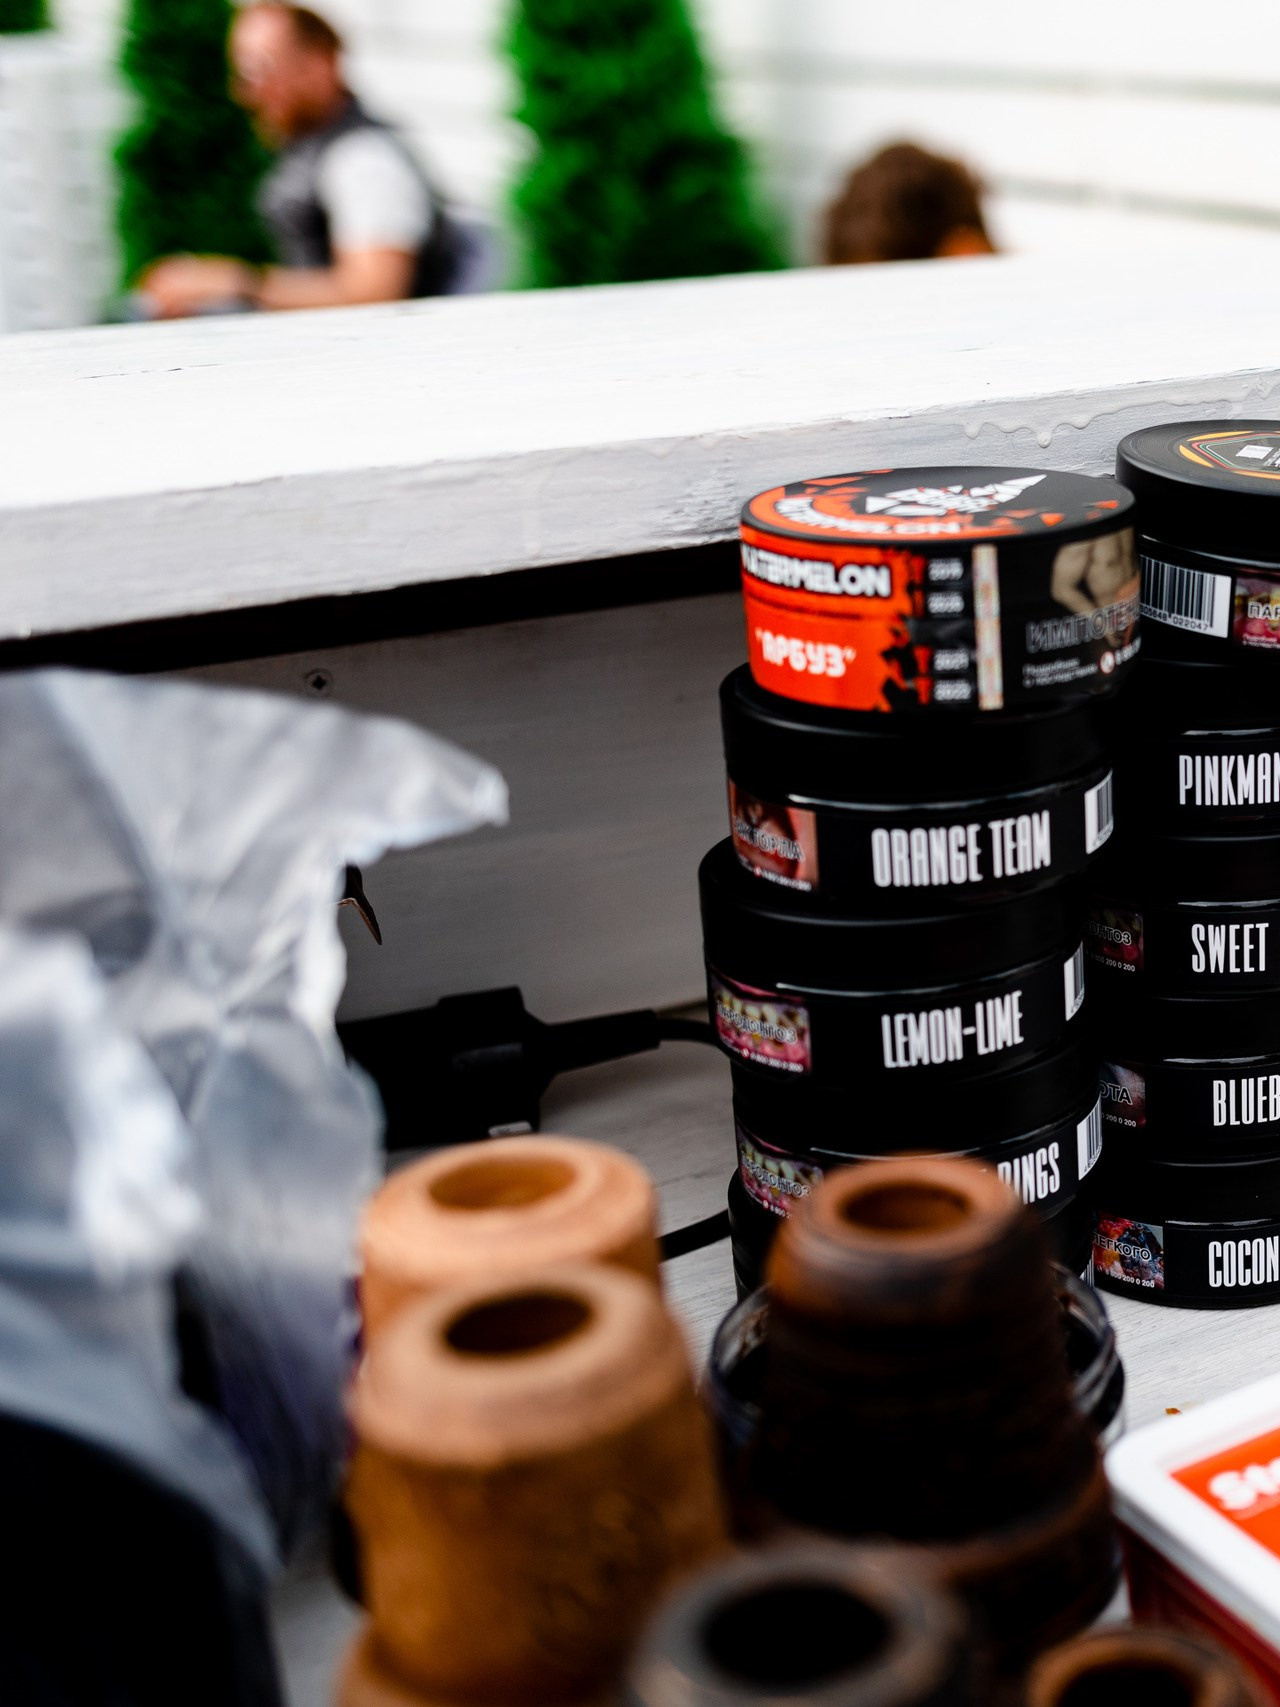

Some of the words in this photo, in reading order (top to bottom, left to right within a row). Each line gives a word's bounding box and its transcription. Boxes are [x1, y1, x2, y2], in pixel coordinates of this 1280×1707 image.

[871, 824, 984, 888] ORANGE
[989, 810, 1051, 878] TEAM
[1191, 922, 1269, 973] SWEET
[881, 990, 1025, 1069] LEMON-LIME
